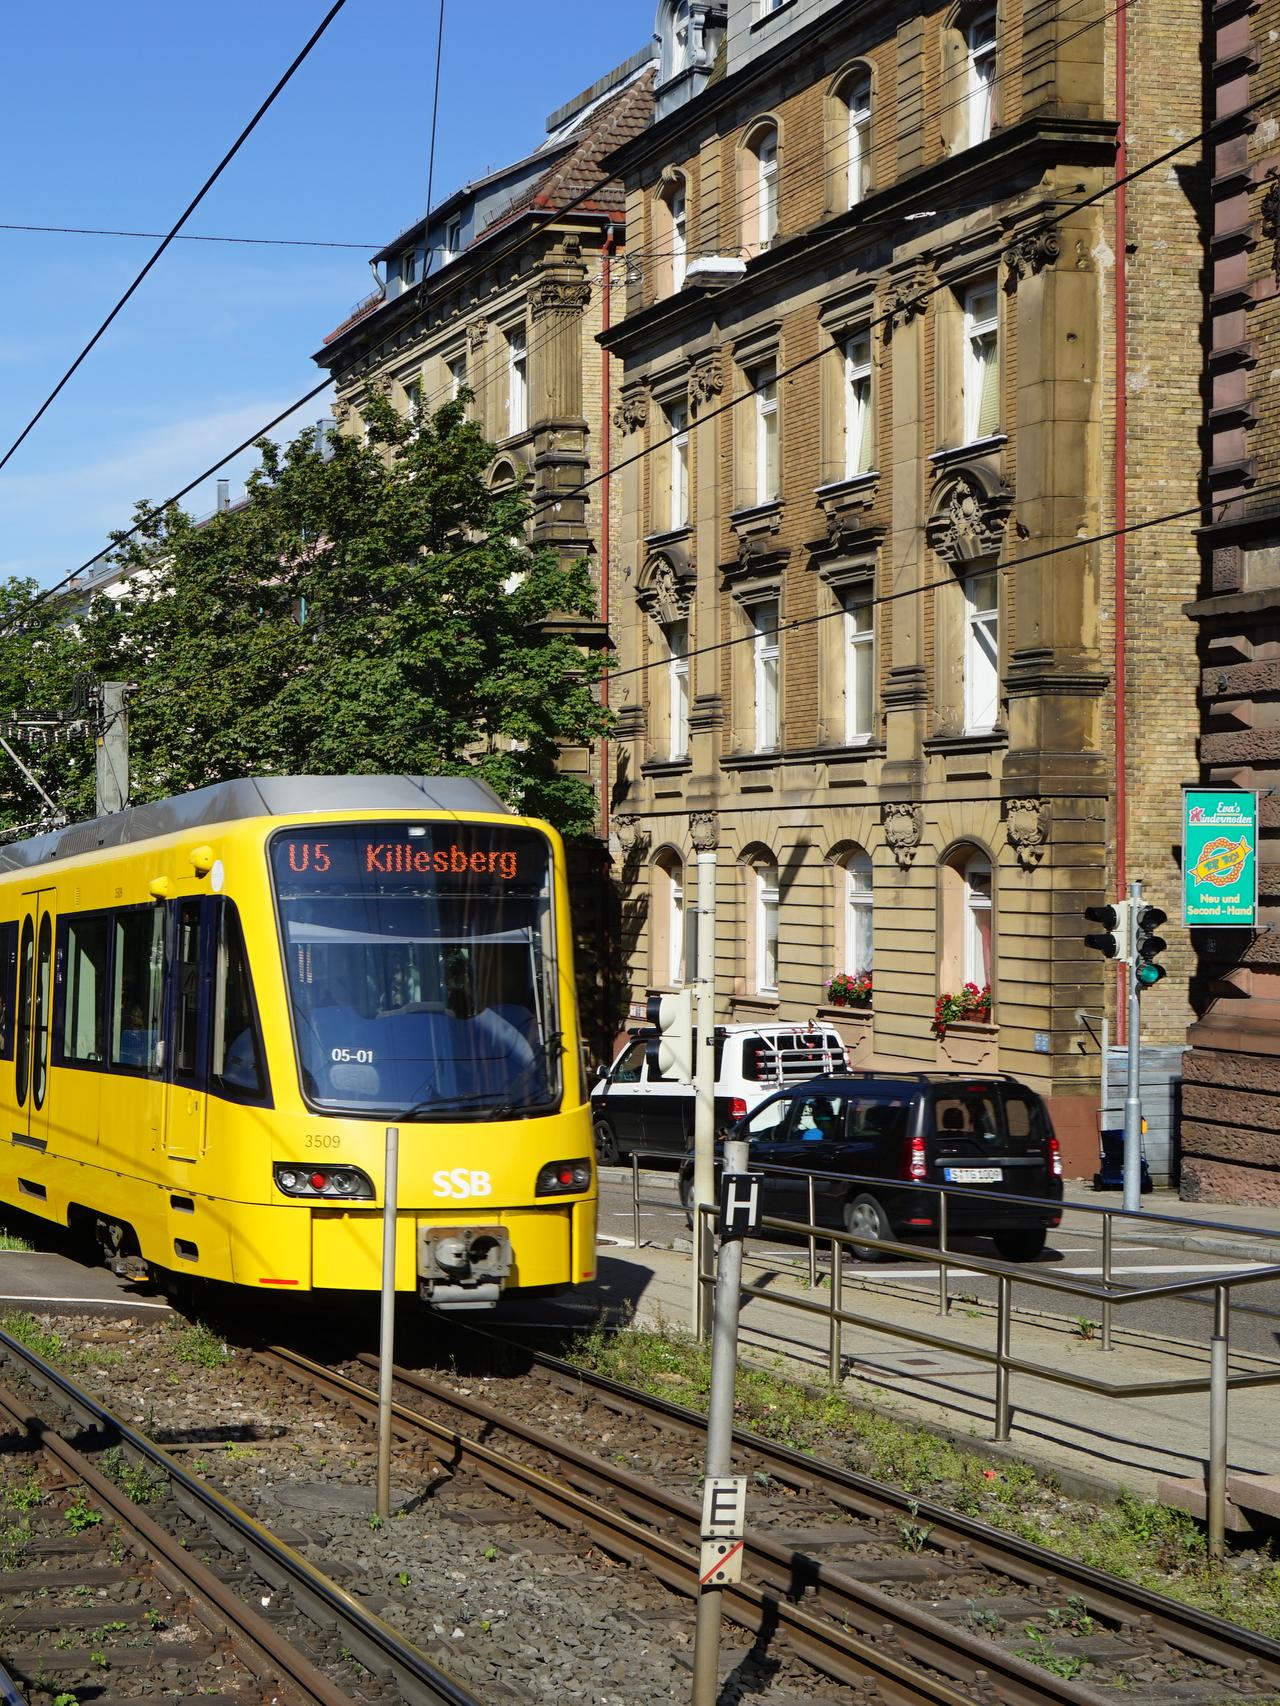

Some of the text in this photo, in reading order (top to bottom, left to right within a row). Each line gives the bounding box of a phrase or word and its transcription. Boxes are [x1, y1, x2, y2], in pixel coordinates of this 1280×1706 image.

[1189, 806, 1252, 824] Kindermoden
[1217, 801, 1241, 813] Eva's
[288, 843, 518, 879] U5 Killesberg
[1200, 893, 1240, 904] Neu und
[331, 1048, 374, 1063] 05-01
[305, 1134, 341, 1149] 3509
[432, 1168, 492, 1199] SSB
[725, 1183, 759, 1226] H
[710, 1488, 738, 1525] E
